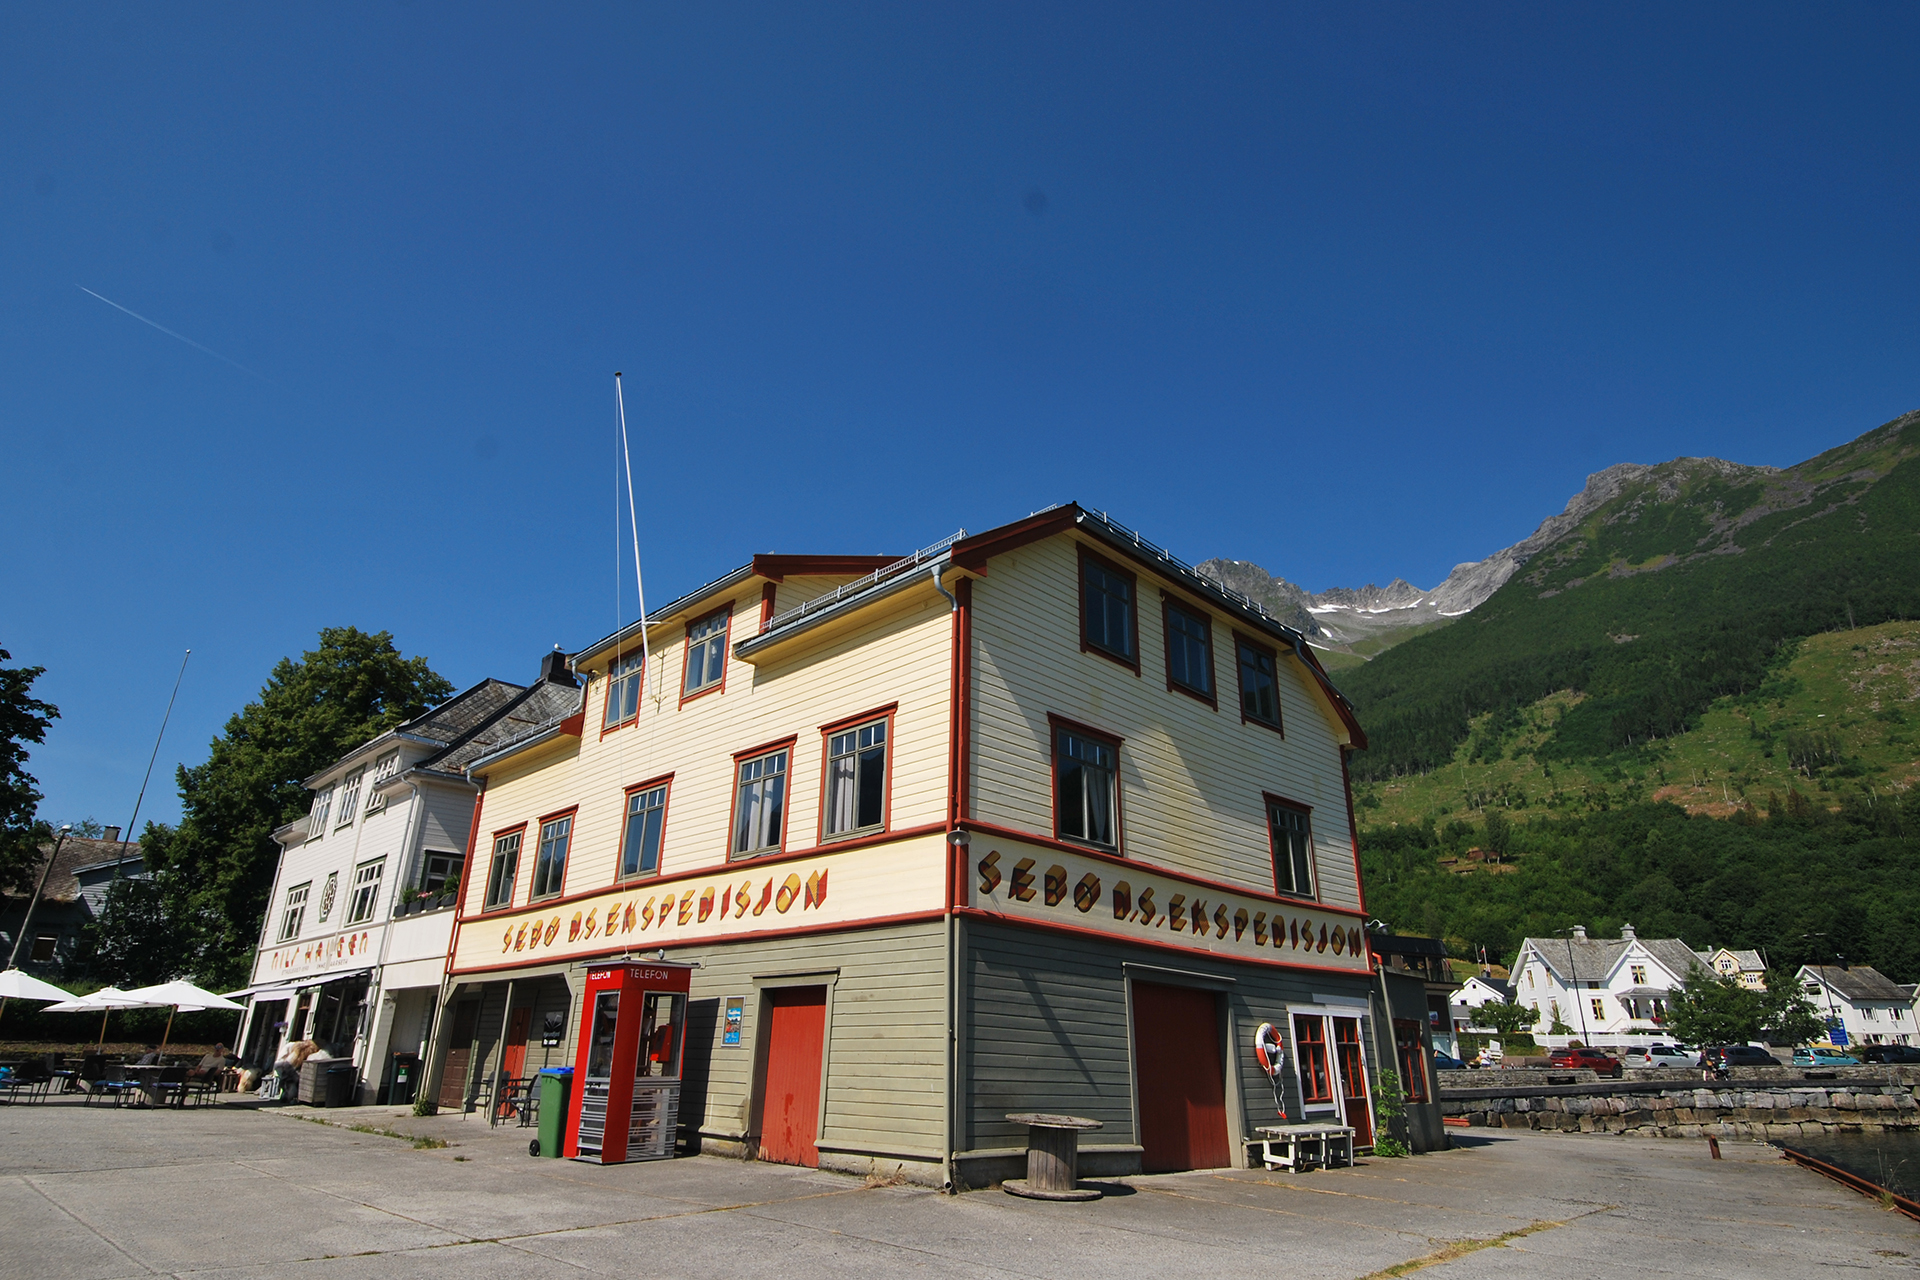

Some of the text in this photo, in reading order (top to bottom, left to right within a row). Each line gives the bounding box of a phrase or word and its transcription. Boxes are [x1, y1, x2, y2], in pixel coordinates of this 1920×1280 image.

[978, 850, 1101, 913] SEBØ
[502, 916, 561, 953] SEBØ
[271, 947, 300, 970] NILS
[589, 970, 611, 980] TELEFON
[630, 969, 668, 980] TELEFON
